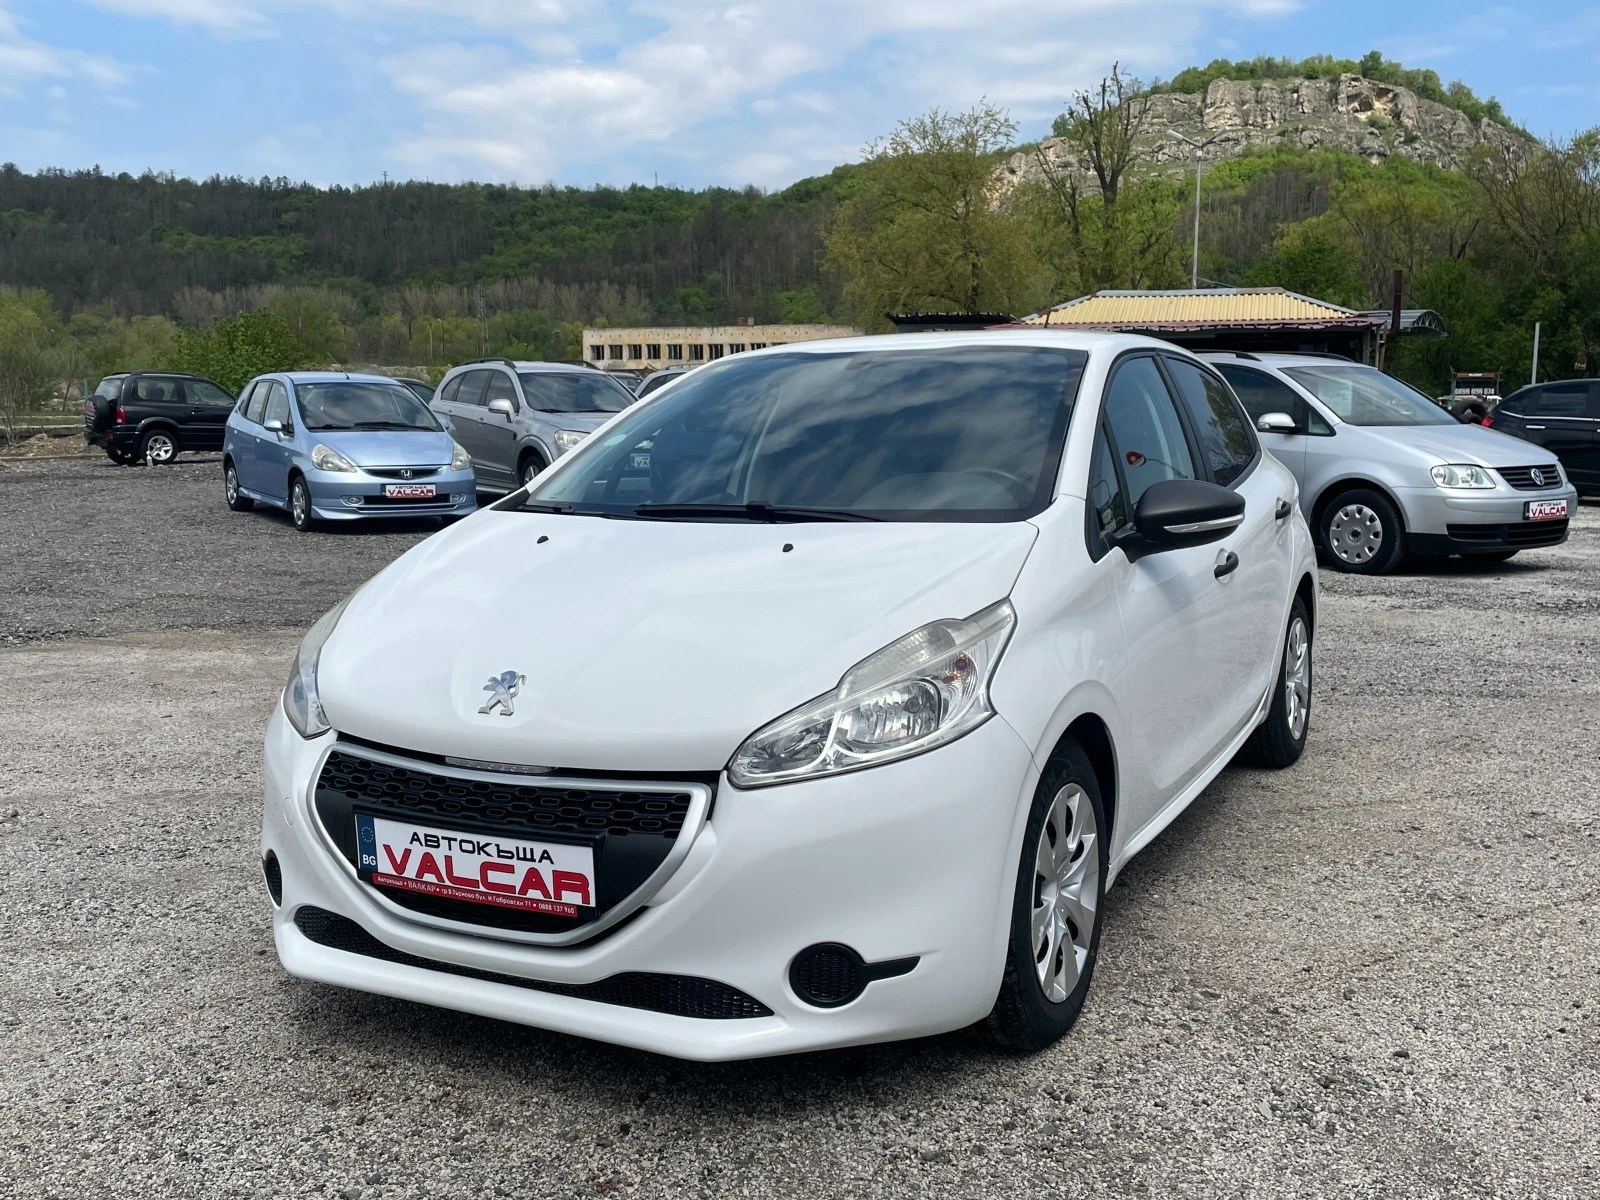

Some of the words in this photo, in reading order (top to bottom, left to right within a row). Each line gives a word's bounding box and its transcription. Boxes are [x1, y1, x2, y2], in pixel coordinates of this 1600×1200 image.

[1531, 506, 1566, 516] VALCAR
[409, 831, 555, 864] АВТОКЪЩА
[362, 854, 376, 866] BG
[383, 843, 591, 905] VALCAR
[407, 880, 436, 892] ВАЛКАР
[553, 904, 563, 912] 137
